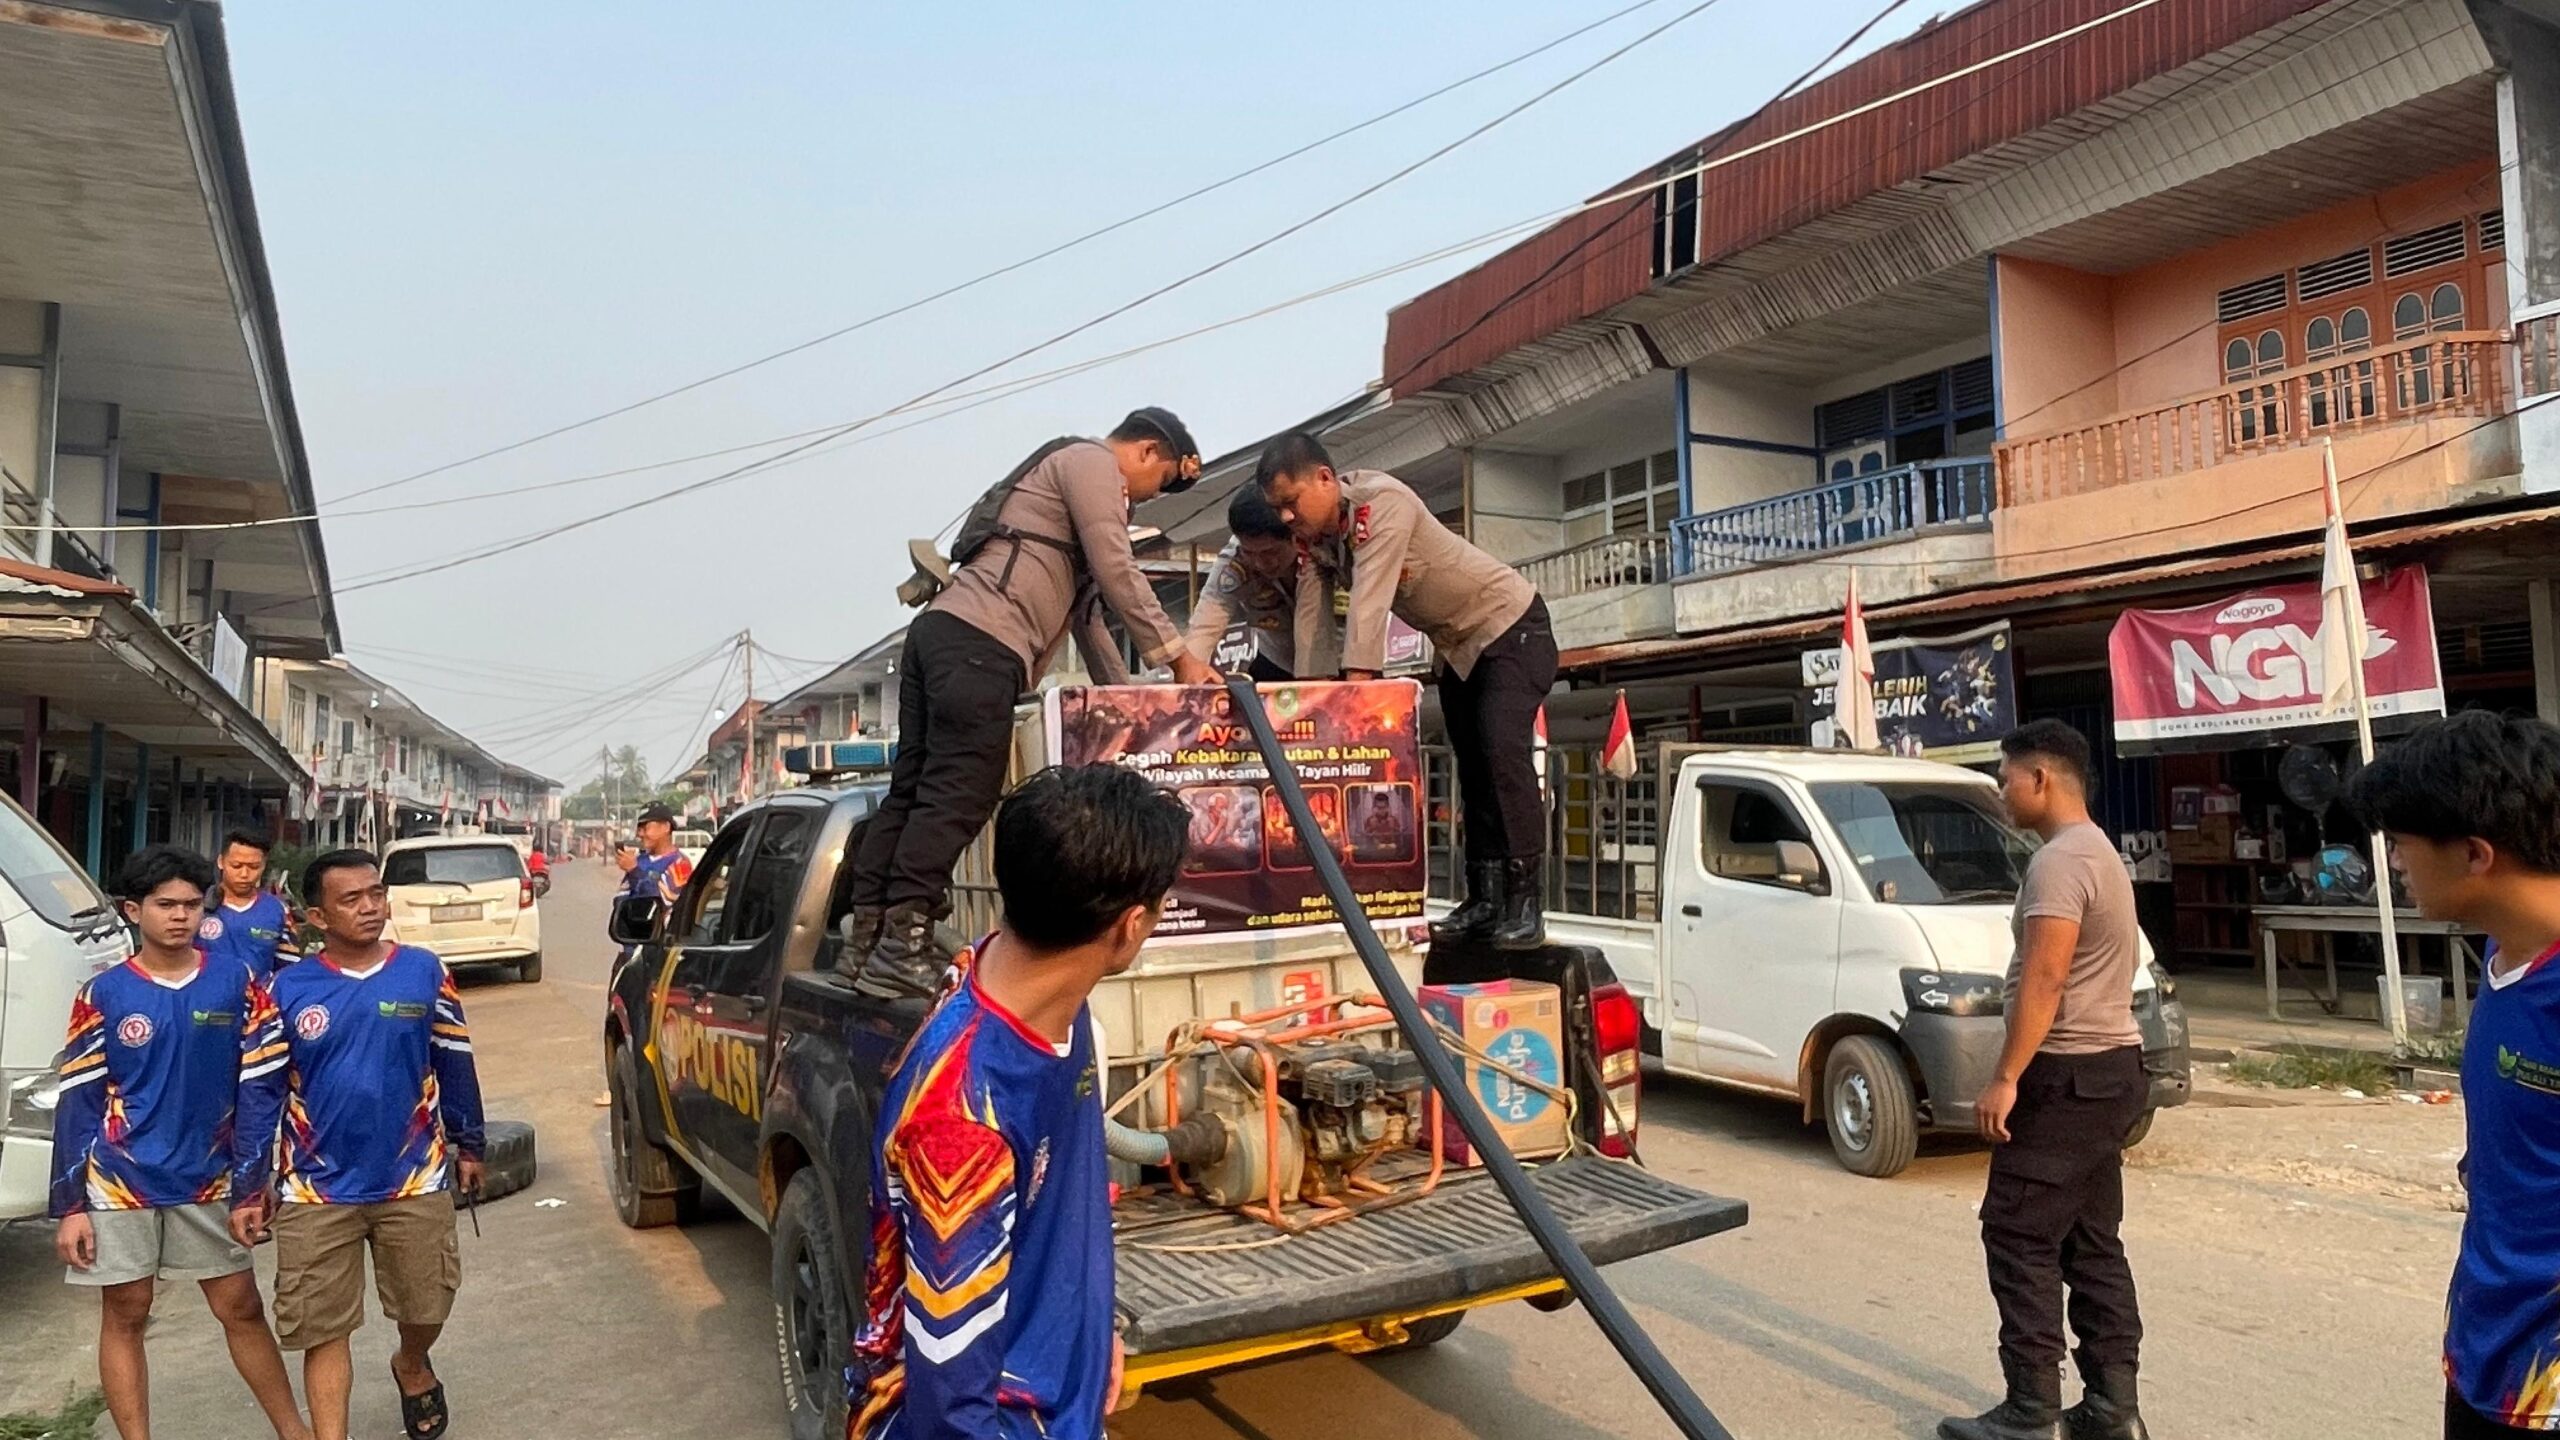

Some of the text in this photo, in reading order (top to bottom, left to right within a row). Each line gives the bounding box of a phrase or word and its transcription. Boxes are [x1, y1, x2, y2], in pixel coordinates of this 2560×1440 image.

[2222, 603, 2276, 619] Nagoya
[1812, 687, 1838, 706] JE
[1874, 694, 1928, 719] BAIK
[2268, 713, 2292, 722] AND
[1114, 750, 1173, 768] Cegah
[1283, 747, 1324, 761] utan
[1327, 746, 1340, 760] &
[1342, 745, 1390, 760] Lahan
[1138, 763, 1371, 784] Wilayah Kecama Tayan Hilir
[1247, 914, 1270, 926] dan
[1271, 912, 1302, 924] udara
[1303, 909, 1333, 921] sehat
[679, 1013, 763, 1123] POLISI
